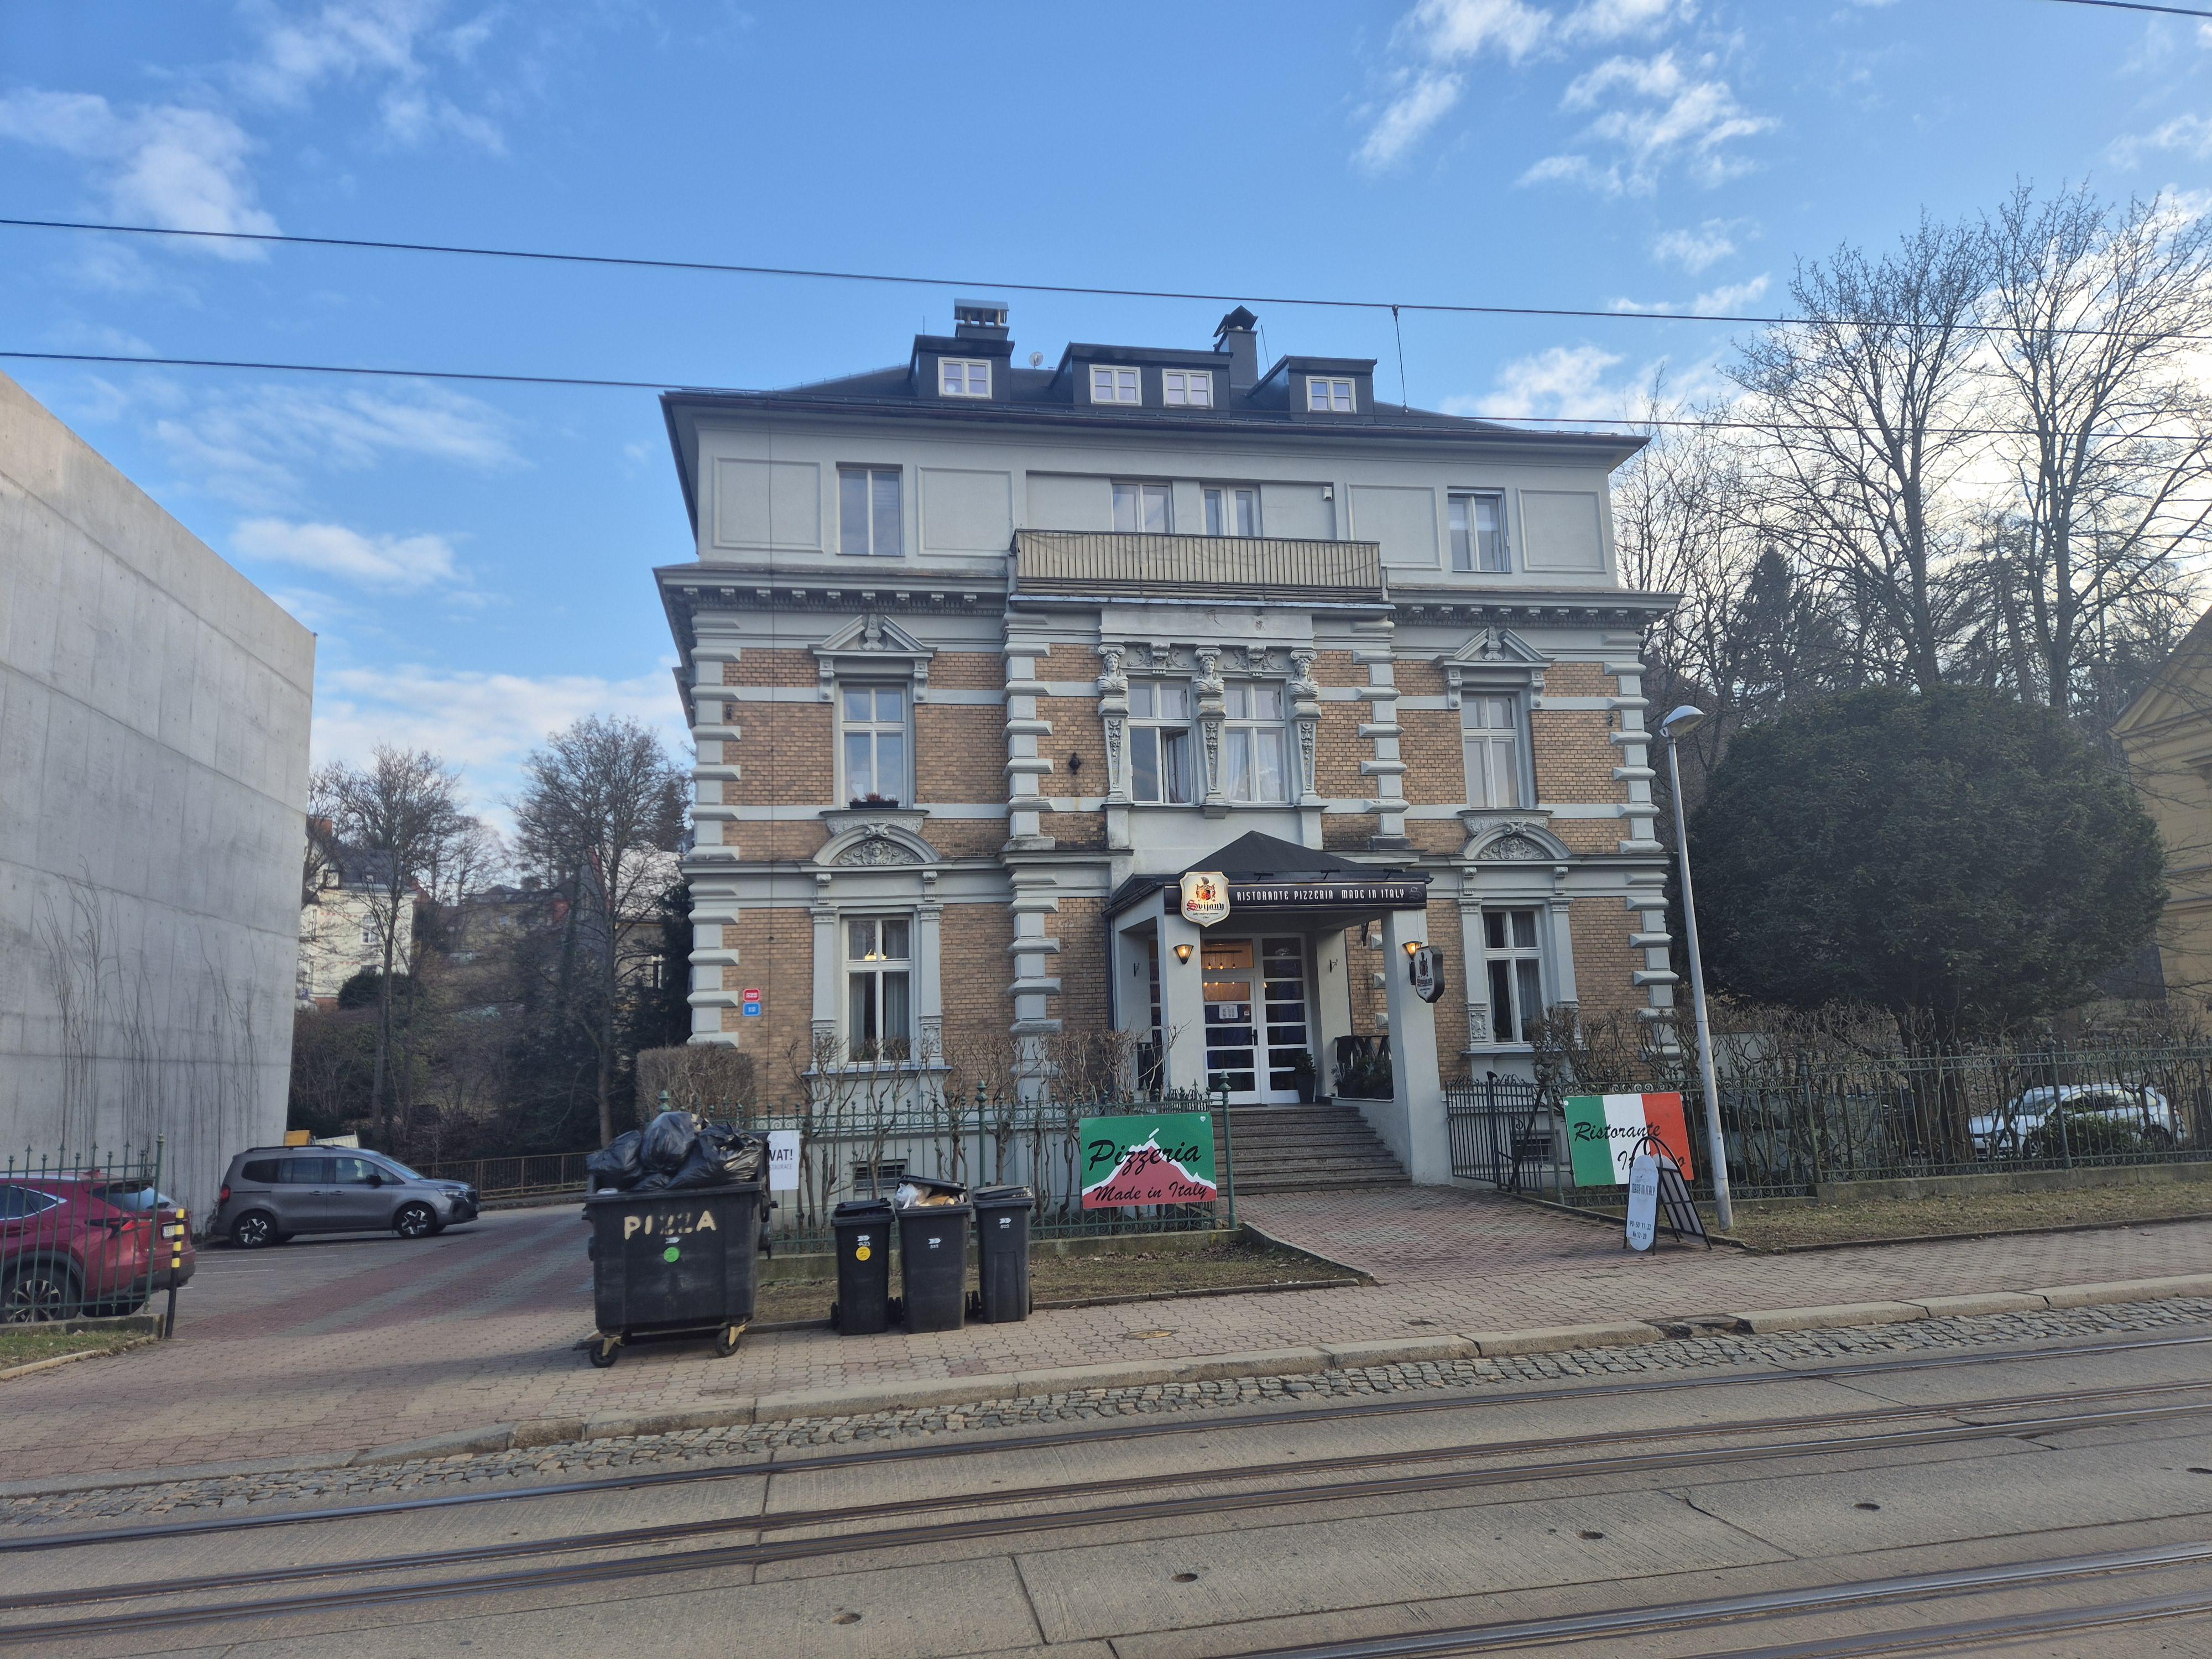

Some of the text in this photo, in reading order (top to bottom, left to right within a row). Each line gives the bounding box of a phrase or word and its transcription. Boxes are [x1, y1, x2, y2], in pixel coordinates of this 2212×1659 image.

[1186, 899, 1224, 911] Svijany
[1237, 889, 1404, 901] RISTORANTE PIZZERIA MADE IN ITALY
[1573, 1121, 1661, 1142] Ristorante
[1088, 1139, 1202, 1176] Pizzeria
[1093, 1181, 1207, 1202] Made in Italy
